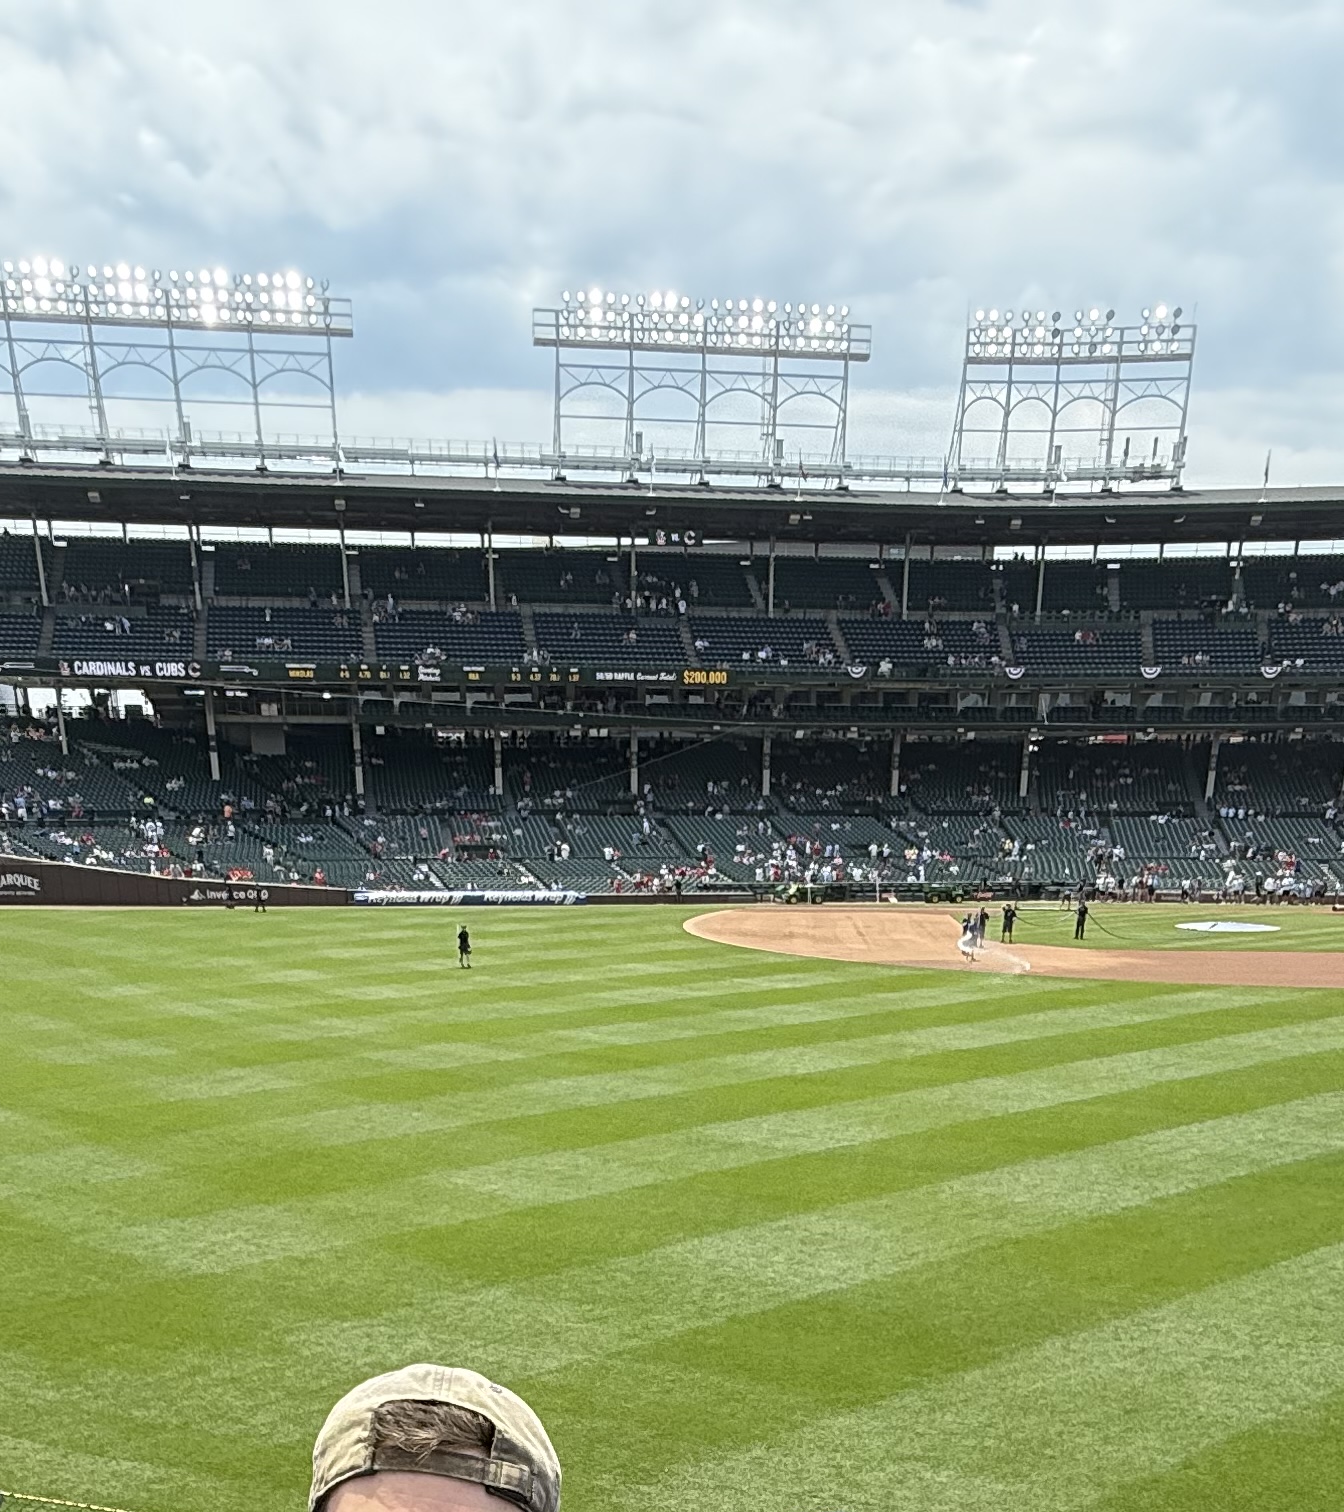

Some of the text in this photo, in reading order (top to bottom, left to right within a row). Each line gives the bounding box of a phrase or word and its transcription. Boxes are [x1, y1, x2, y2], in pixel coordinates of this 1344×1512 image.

[73, 660, 137, 677] CARDINALS
[155, 662, 186, 677] CUBS
[682, 669, 728, 685] $200,000
[206, 889, 246, 901] Inveco
